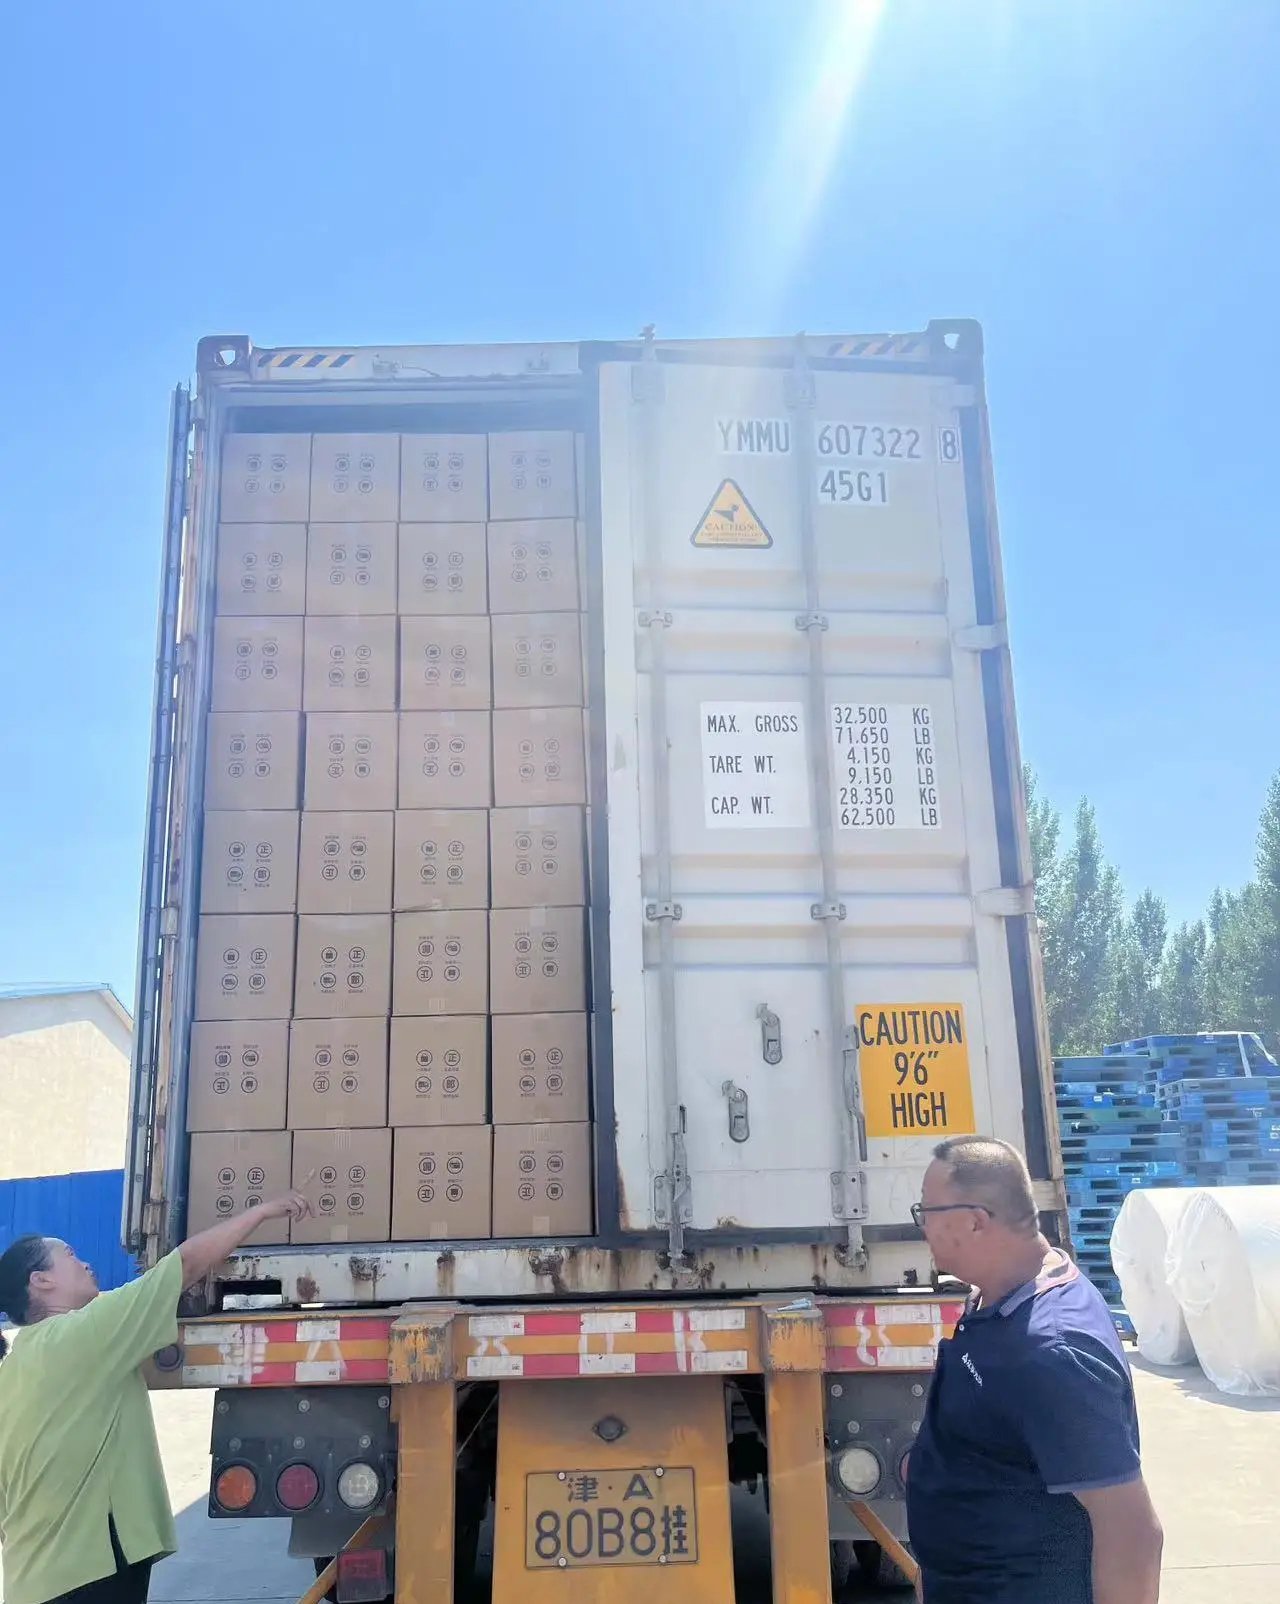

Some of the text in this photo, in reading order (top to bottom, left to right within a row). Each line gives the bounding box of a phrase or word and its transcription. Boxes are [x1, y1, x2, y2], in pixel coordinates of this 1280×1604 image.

[717, 420, 957, 460] YMMU 607322 8
[820, 469, 887, 503] 45G1
[707, 715, 798, 733] MAX. GROSS
[912, 708, 930, 725] KG
[914, 728, 931, 745] LB
[709, 755, 776, 773] TARE WT.
[916, 748, 933, 765] KG
[917, 768, 934, 785] LB
[711, 796, 774, 814] CAP. WT.
[919, 788, 937, 805] KG
[921, 808, 938, 825] LB
[860, 1010, 962, 1046] CAUTION
[891, 1091, 947, 1128] HIGH
